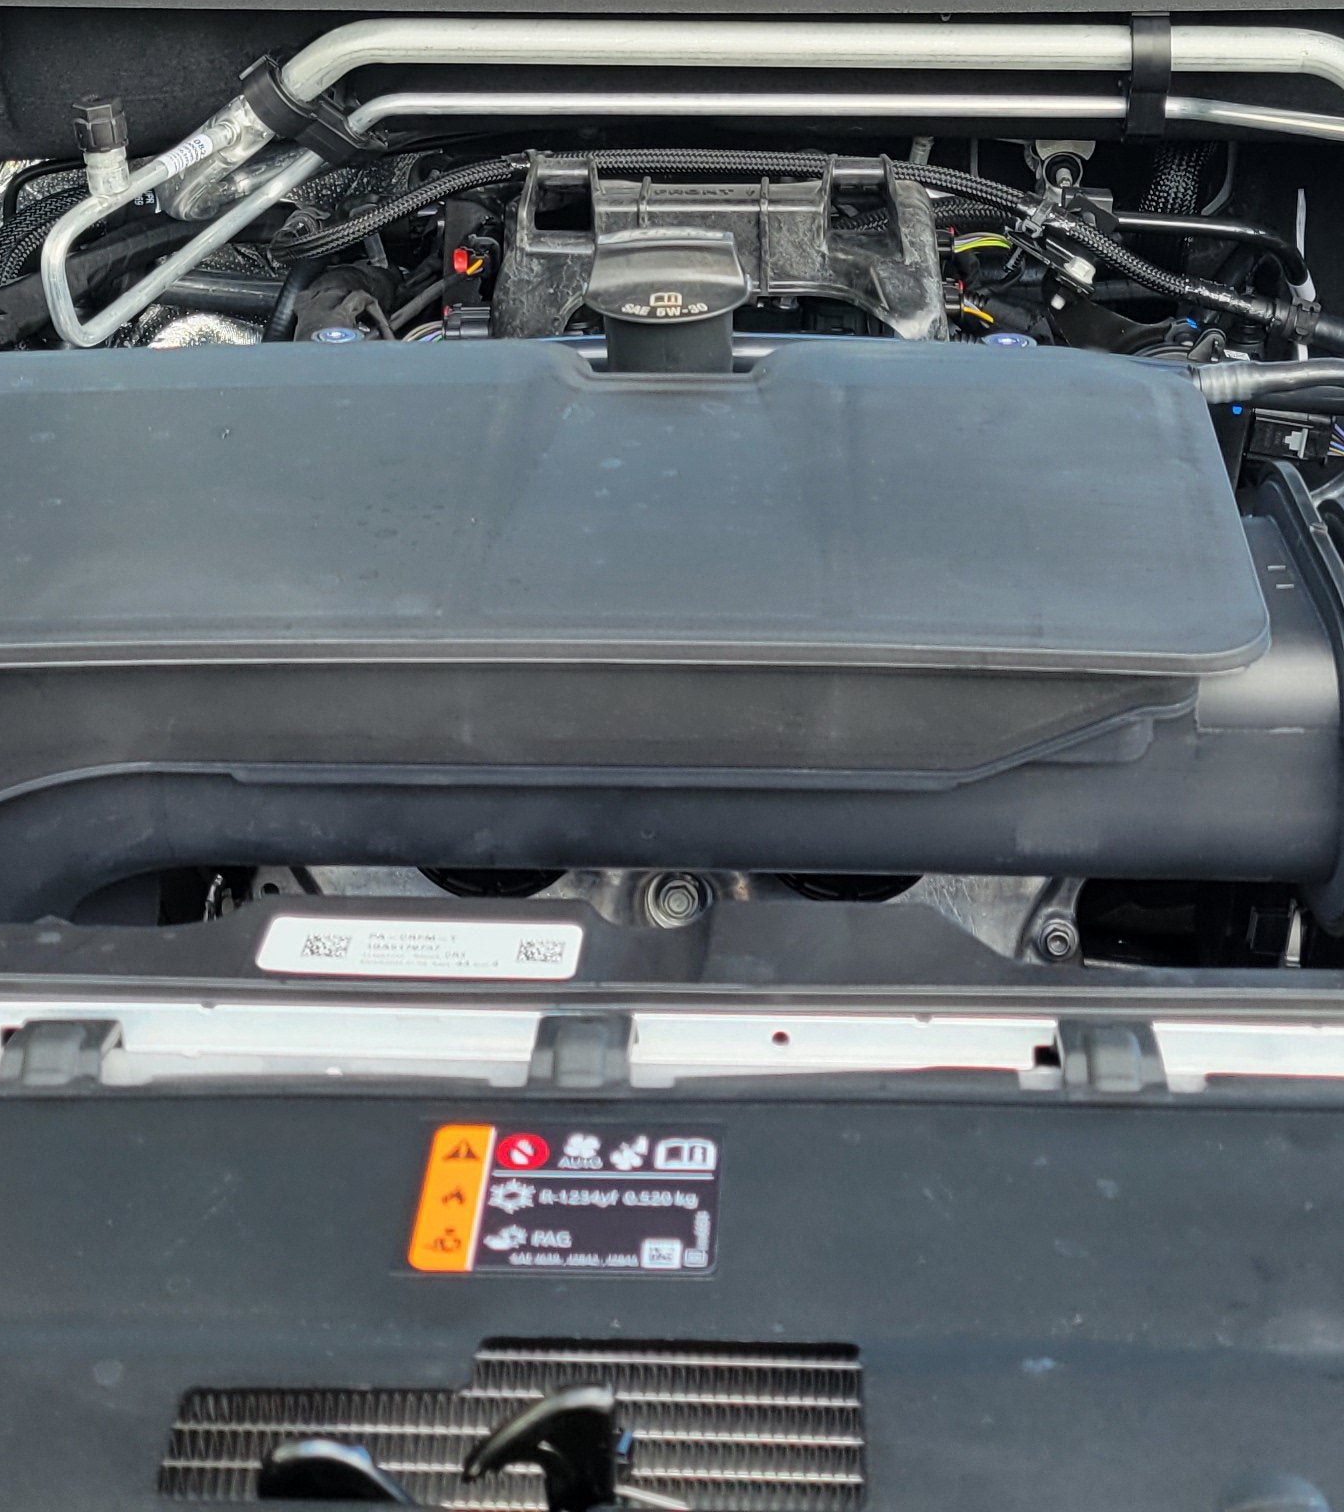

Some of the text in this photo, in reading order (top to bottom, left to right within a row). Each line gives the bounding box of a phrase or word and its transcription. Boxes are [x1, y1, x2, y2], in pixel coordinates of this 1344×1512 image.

[621, 302, 708, 316] SAE 5W-30
[558, 1156, 603, 1169] AUTO
[674, 1189, 699, 1209] kg
[531, 1230, 572, 1248] PAG
